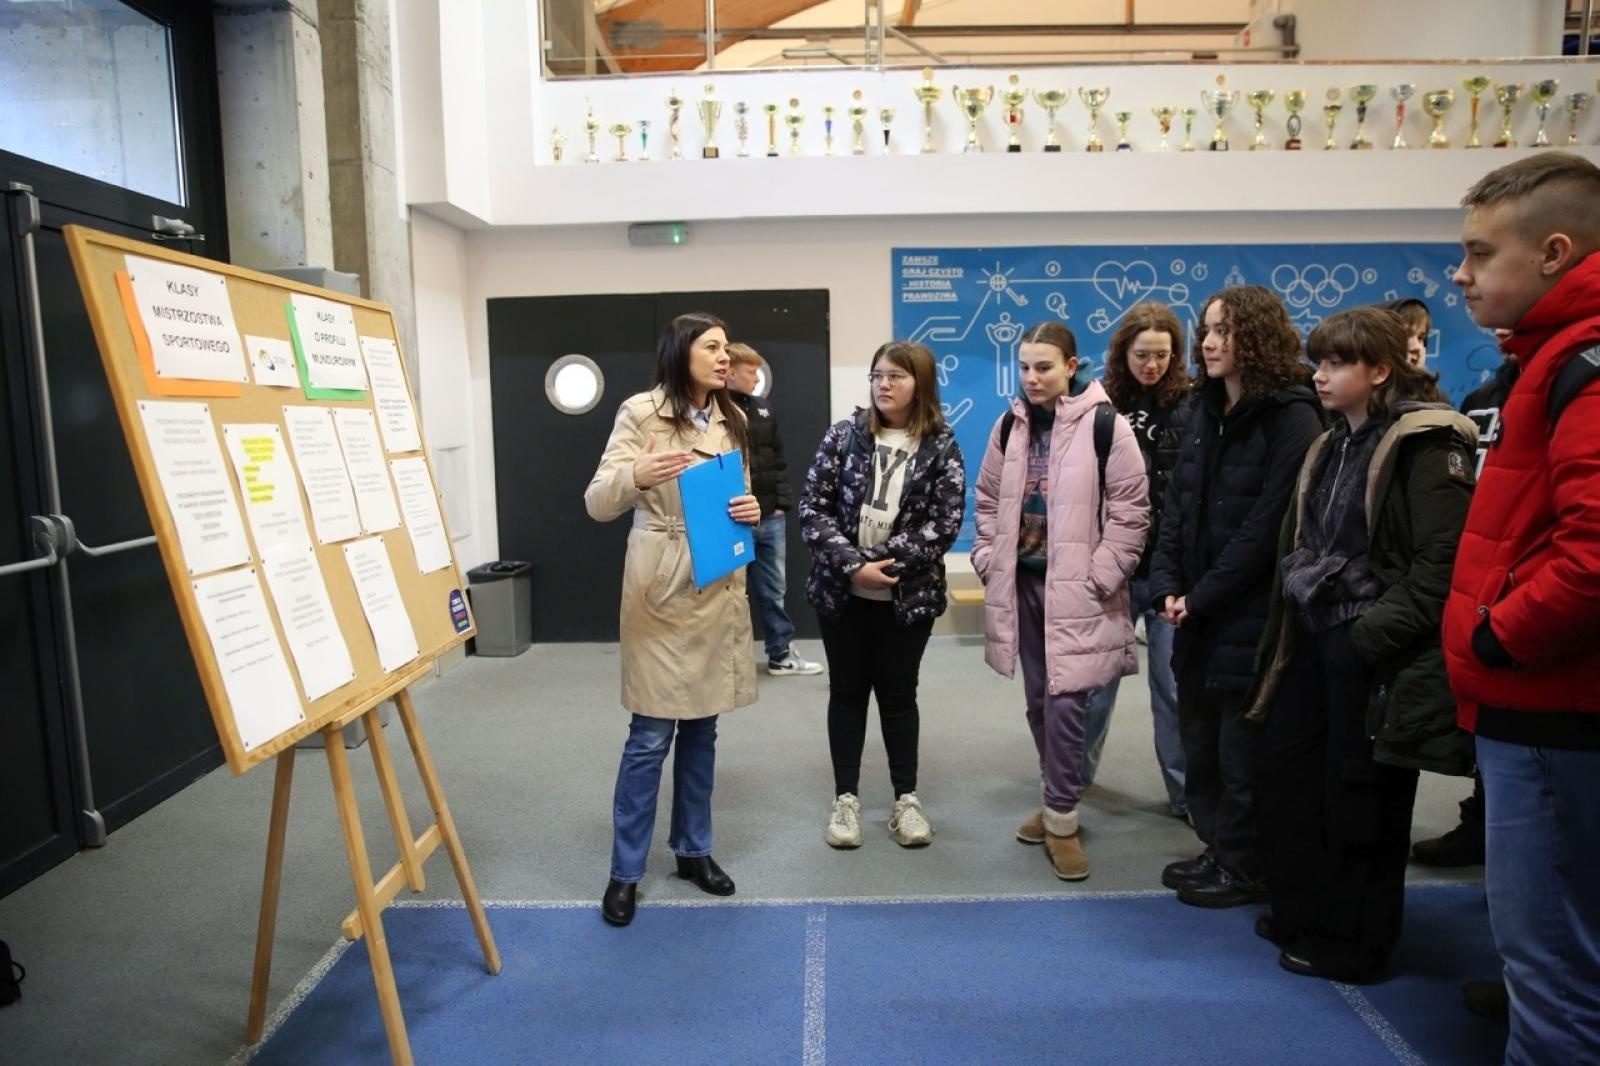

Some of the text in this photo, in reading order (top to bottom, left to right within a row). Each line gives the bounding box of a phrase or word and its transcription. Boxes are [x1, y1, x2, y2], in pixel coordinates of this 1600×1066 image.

[902, 256, 938, 265] ZAWSZE
[902, 268, 963, 277] GRAJ CZYSTO
[166, 280, 199, 297] KLASY
[909, 280, 951, 289] HISTORIA
[902, 292, 957, 300] PRAWDZIWA
[152, 305, 223, 327] MISTRZOSTWA
[316, 311, 335, 324] KLASY
[162, 333, 230, 353] SPORTOWEGO
[321, 333, 346, 346] PROFILU
[312, 353, 356, 367] MUNDUROWYM
